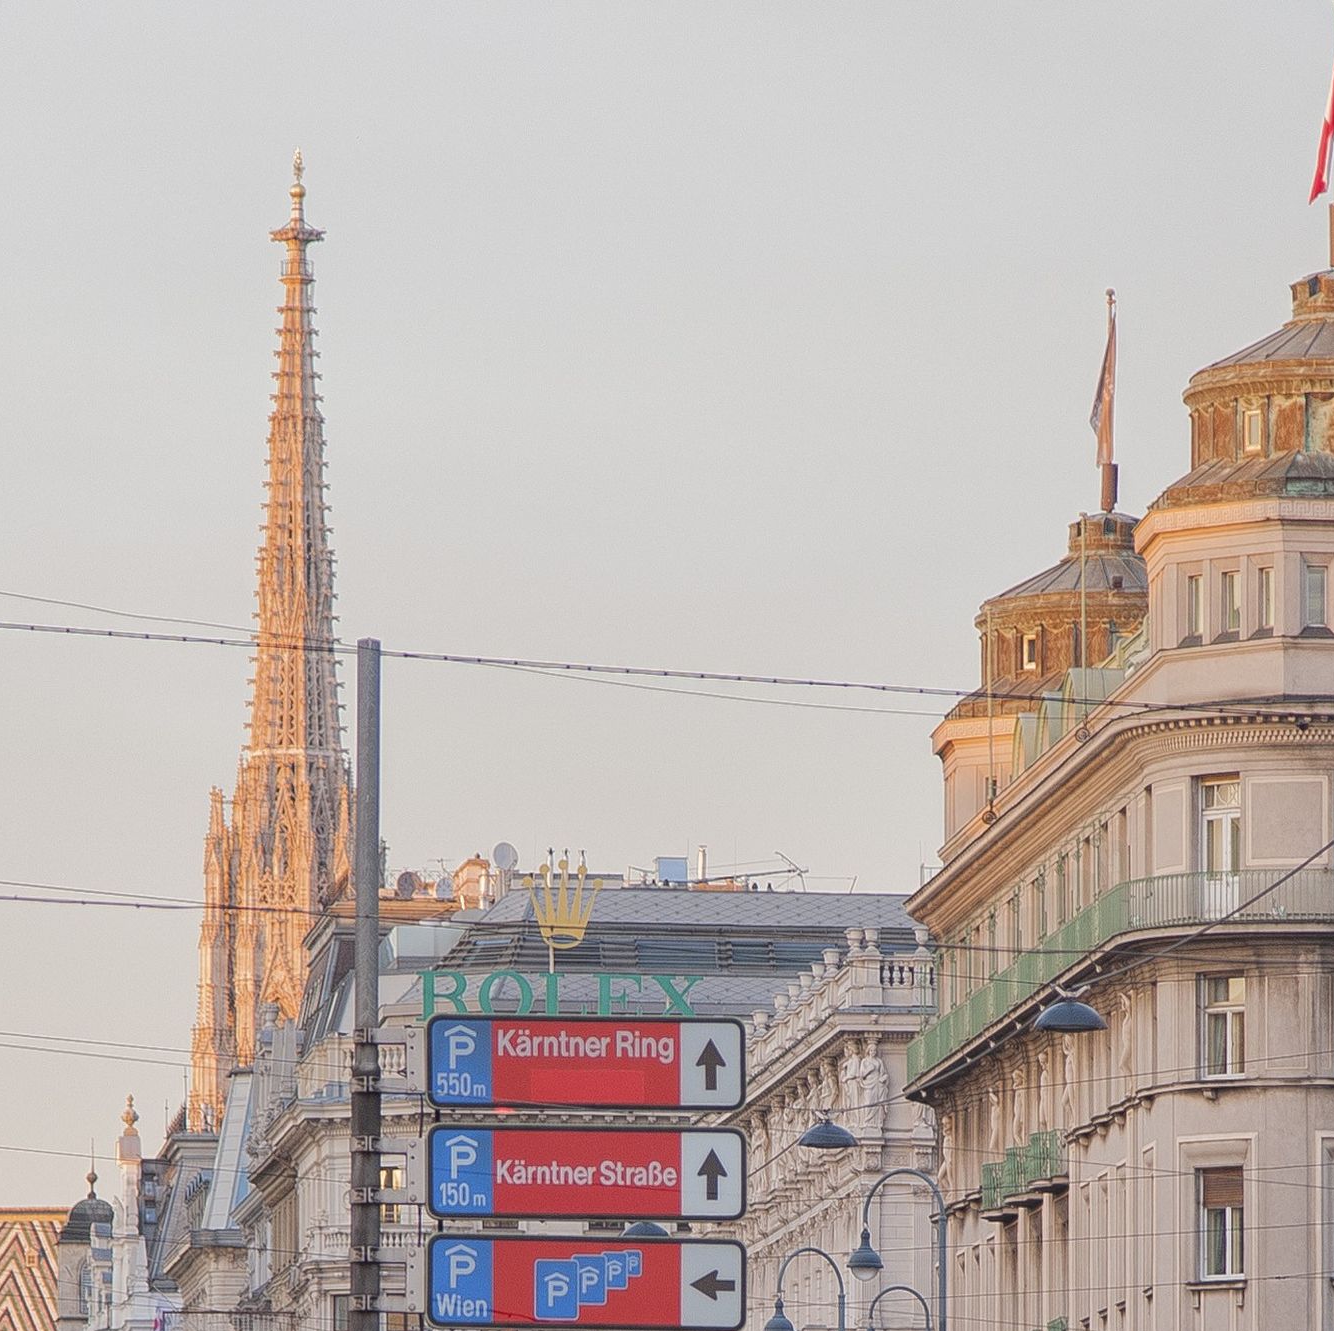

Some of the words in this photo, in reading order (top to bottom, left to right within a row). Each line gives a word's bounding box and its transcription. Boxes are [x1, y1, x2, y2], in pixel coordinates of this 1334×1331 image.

[416, 970, 704, 1021] ROLEX
[497, 1029, 610, 1058] Kärntner
[616, 1030, 675, 1063] Ring
[496, 1160, 596, 1185] Kärntner
[600, 1161, 678, 1187] Straße
[436, 1294, 488, 1318] Wien
